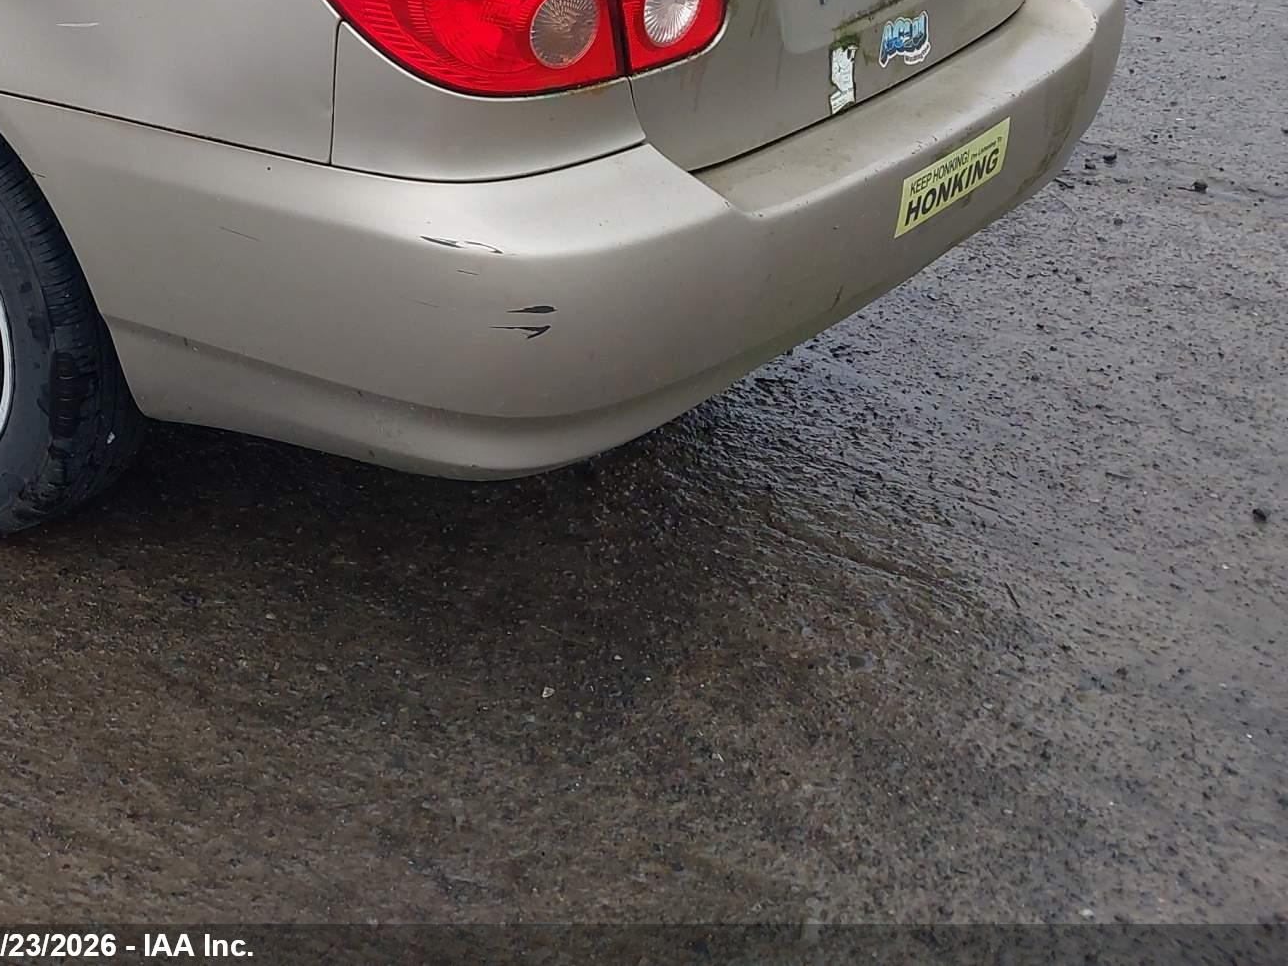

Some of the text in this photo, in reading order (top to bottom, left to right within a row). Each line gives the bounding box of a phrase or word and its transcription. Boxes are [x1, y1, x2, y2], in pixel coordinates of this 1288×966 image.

[904, 147, 1000, 227] HONKING
[910, 149, 970, 196] KEEP HONKING!
